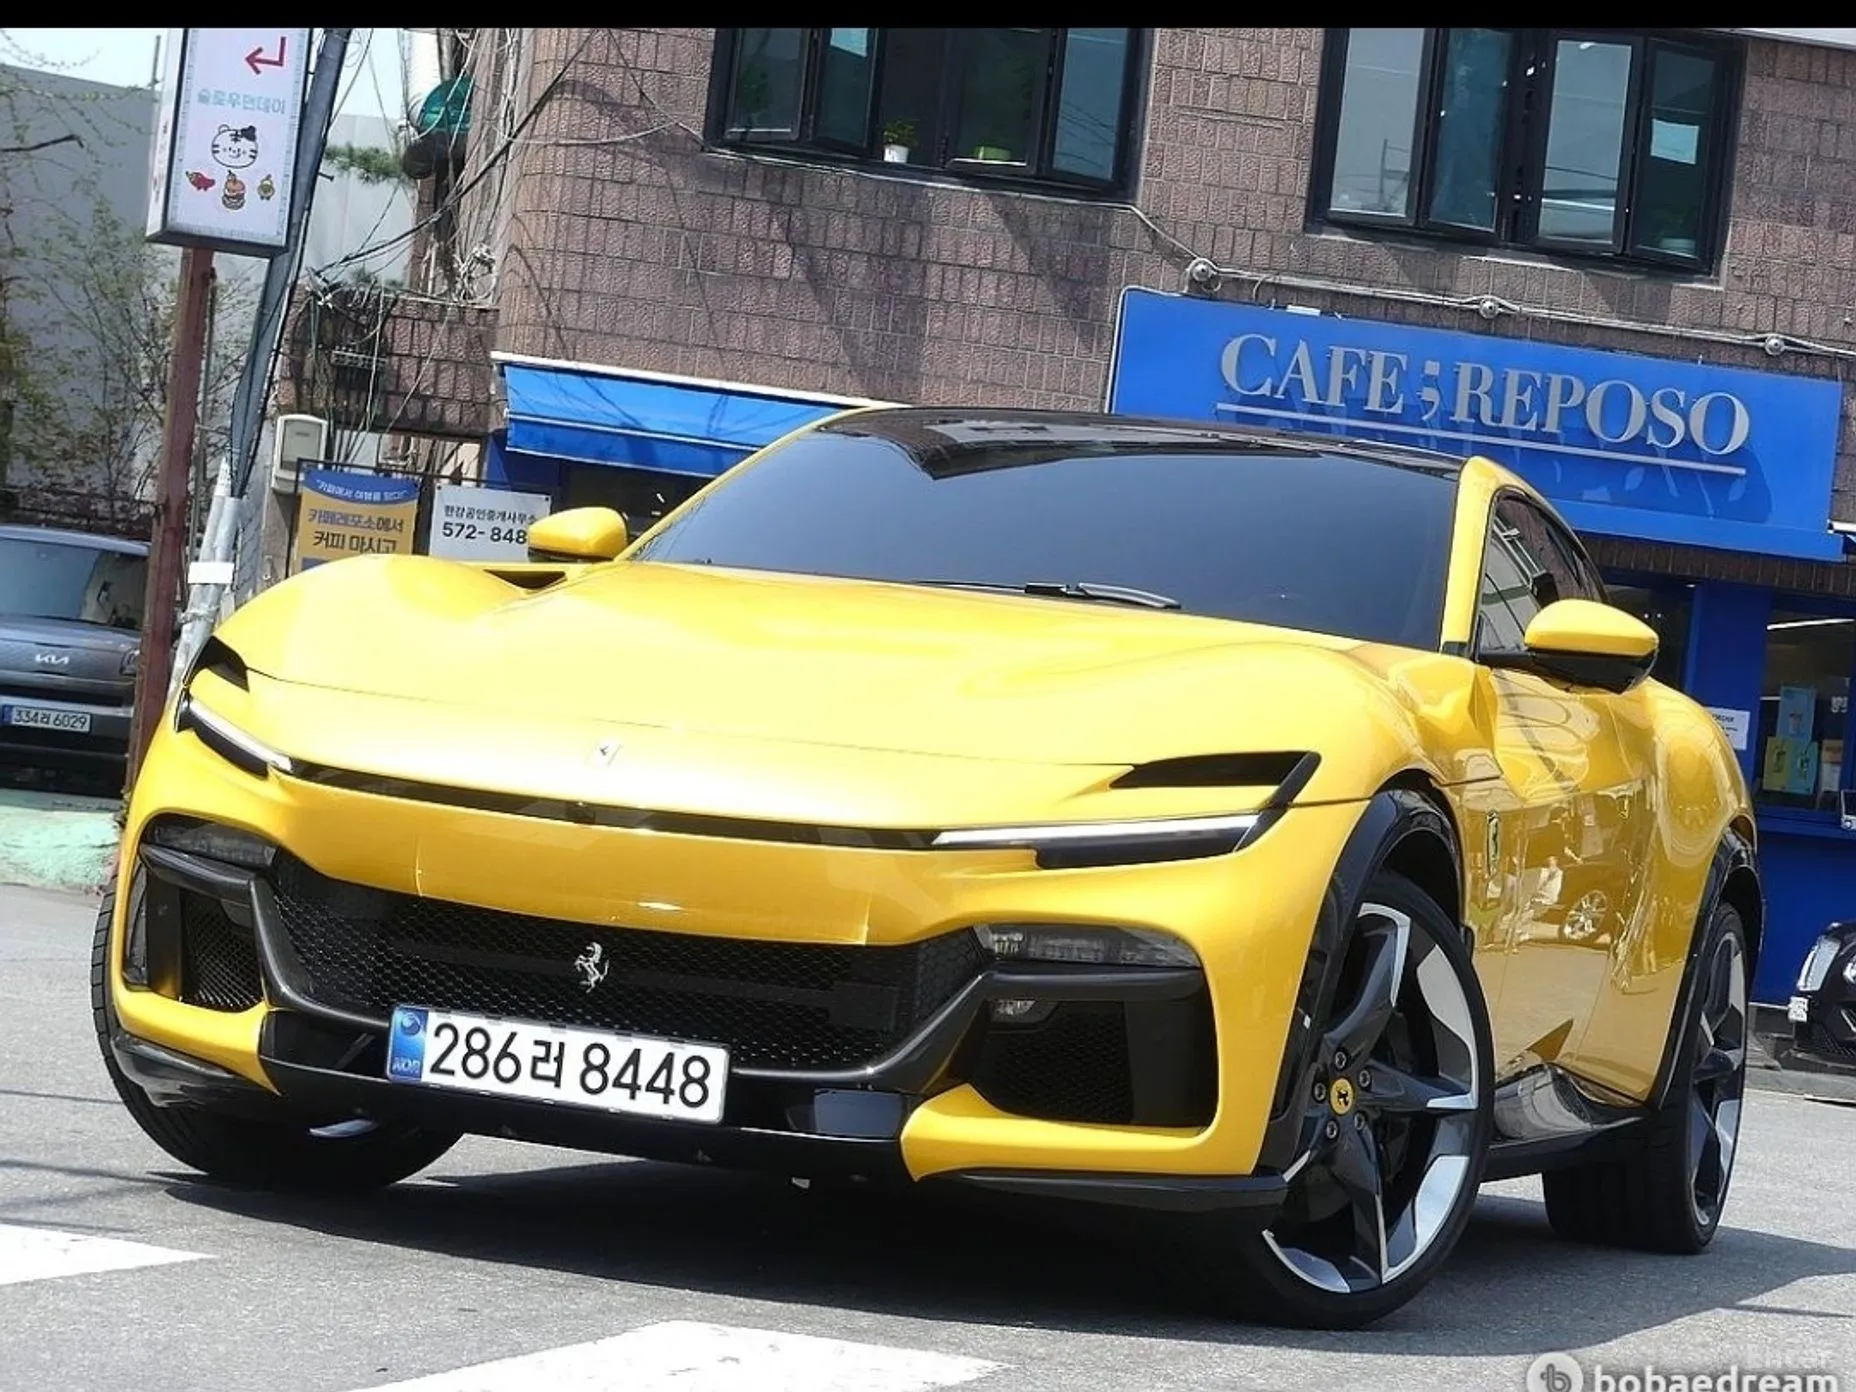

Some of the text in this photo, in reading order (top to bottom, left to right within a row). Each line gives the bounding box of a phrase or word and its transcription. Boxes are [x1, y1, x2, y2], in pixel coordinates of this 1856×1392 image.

[198, 88, 286, 114] 슬로우먼데이
[312, 531, 397, 553] 커피 마시고
[53, 712, 88, 729] 6029
[429, 1021, 711, 1109] 286러 8448
